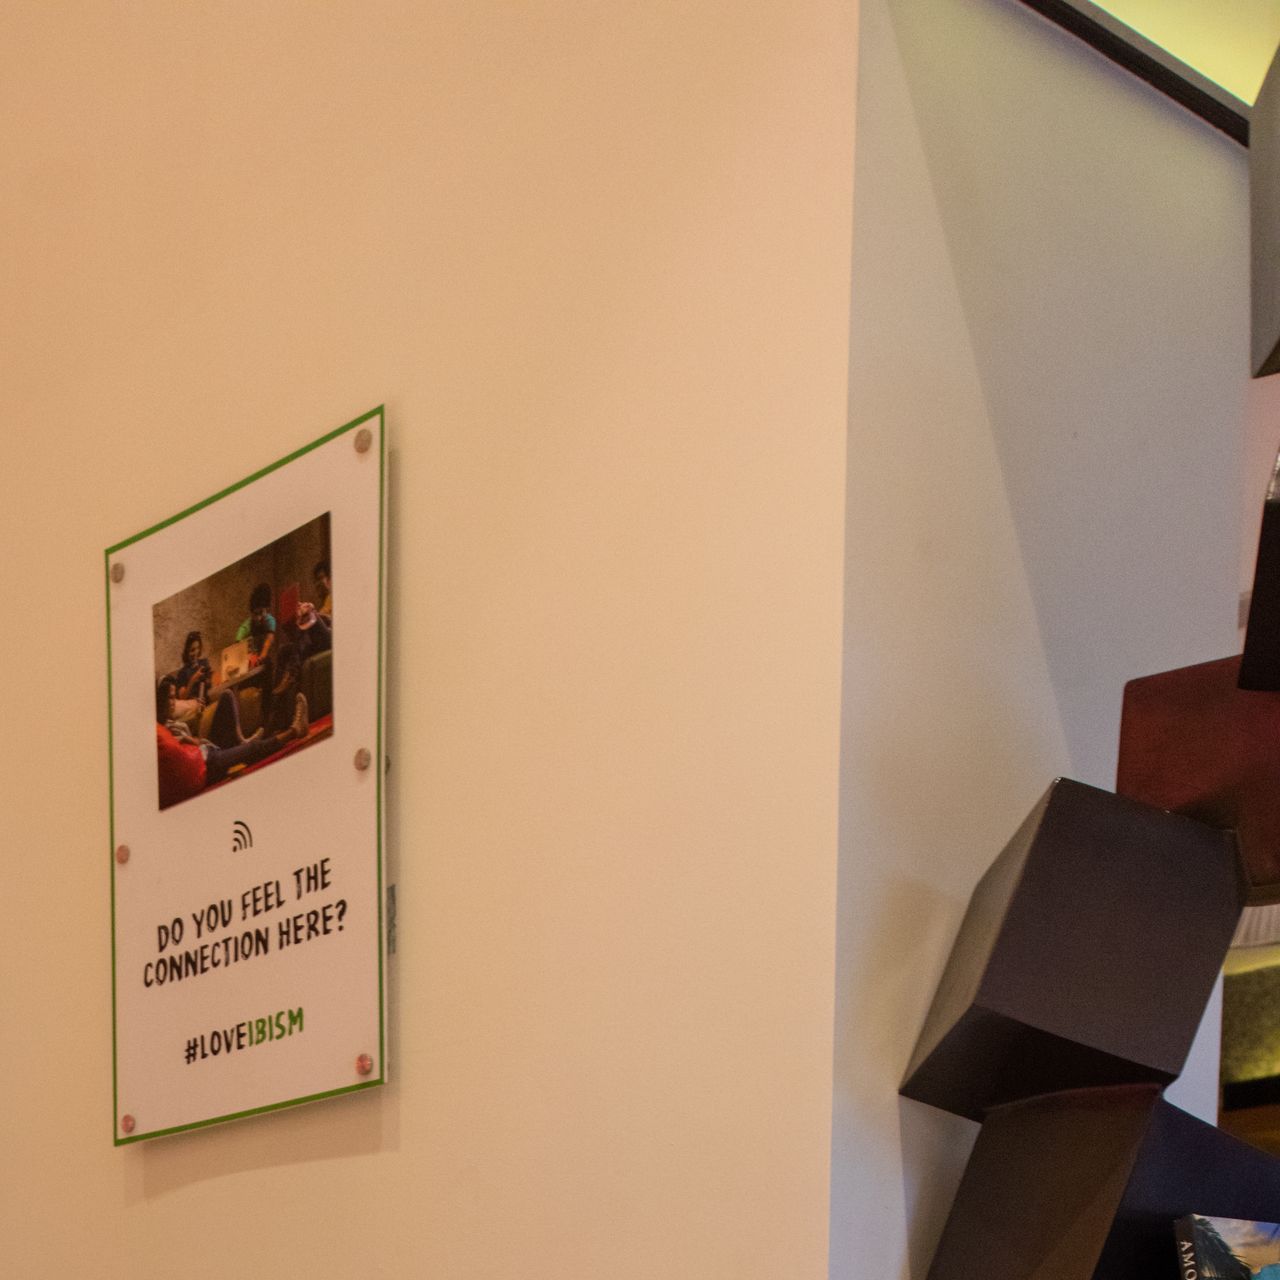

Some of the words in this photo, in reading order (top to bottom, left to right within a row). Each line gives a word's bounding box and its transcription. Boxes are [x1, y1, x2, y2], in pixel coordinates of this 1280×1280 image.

[143, 926, 270, 988] CONNECTION
[278, 899, 348, 950] HERE?
[157, 917, 184, 953] DO
[192, 899, 233, 939] YOU
[241, 880, 286, 921] FEEL
[293, 857, 332, 900] THE
[184, 1006, 305, 1065] #LOVEIBISM
